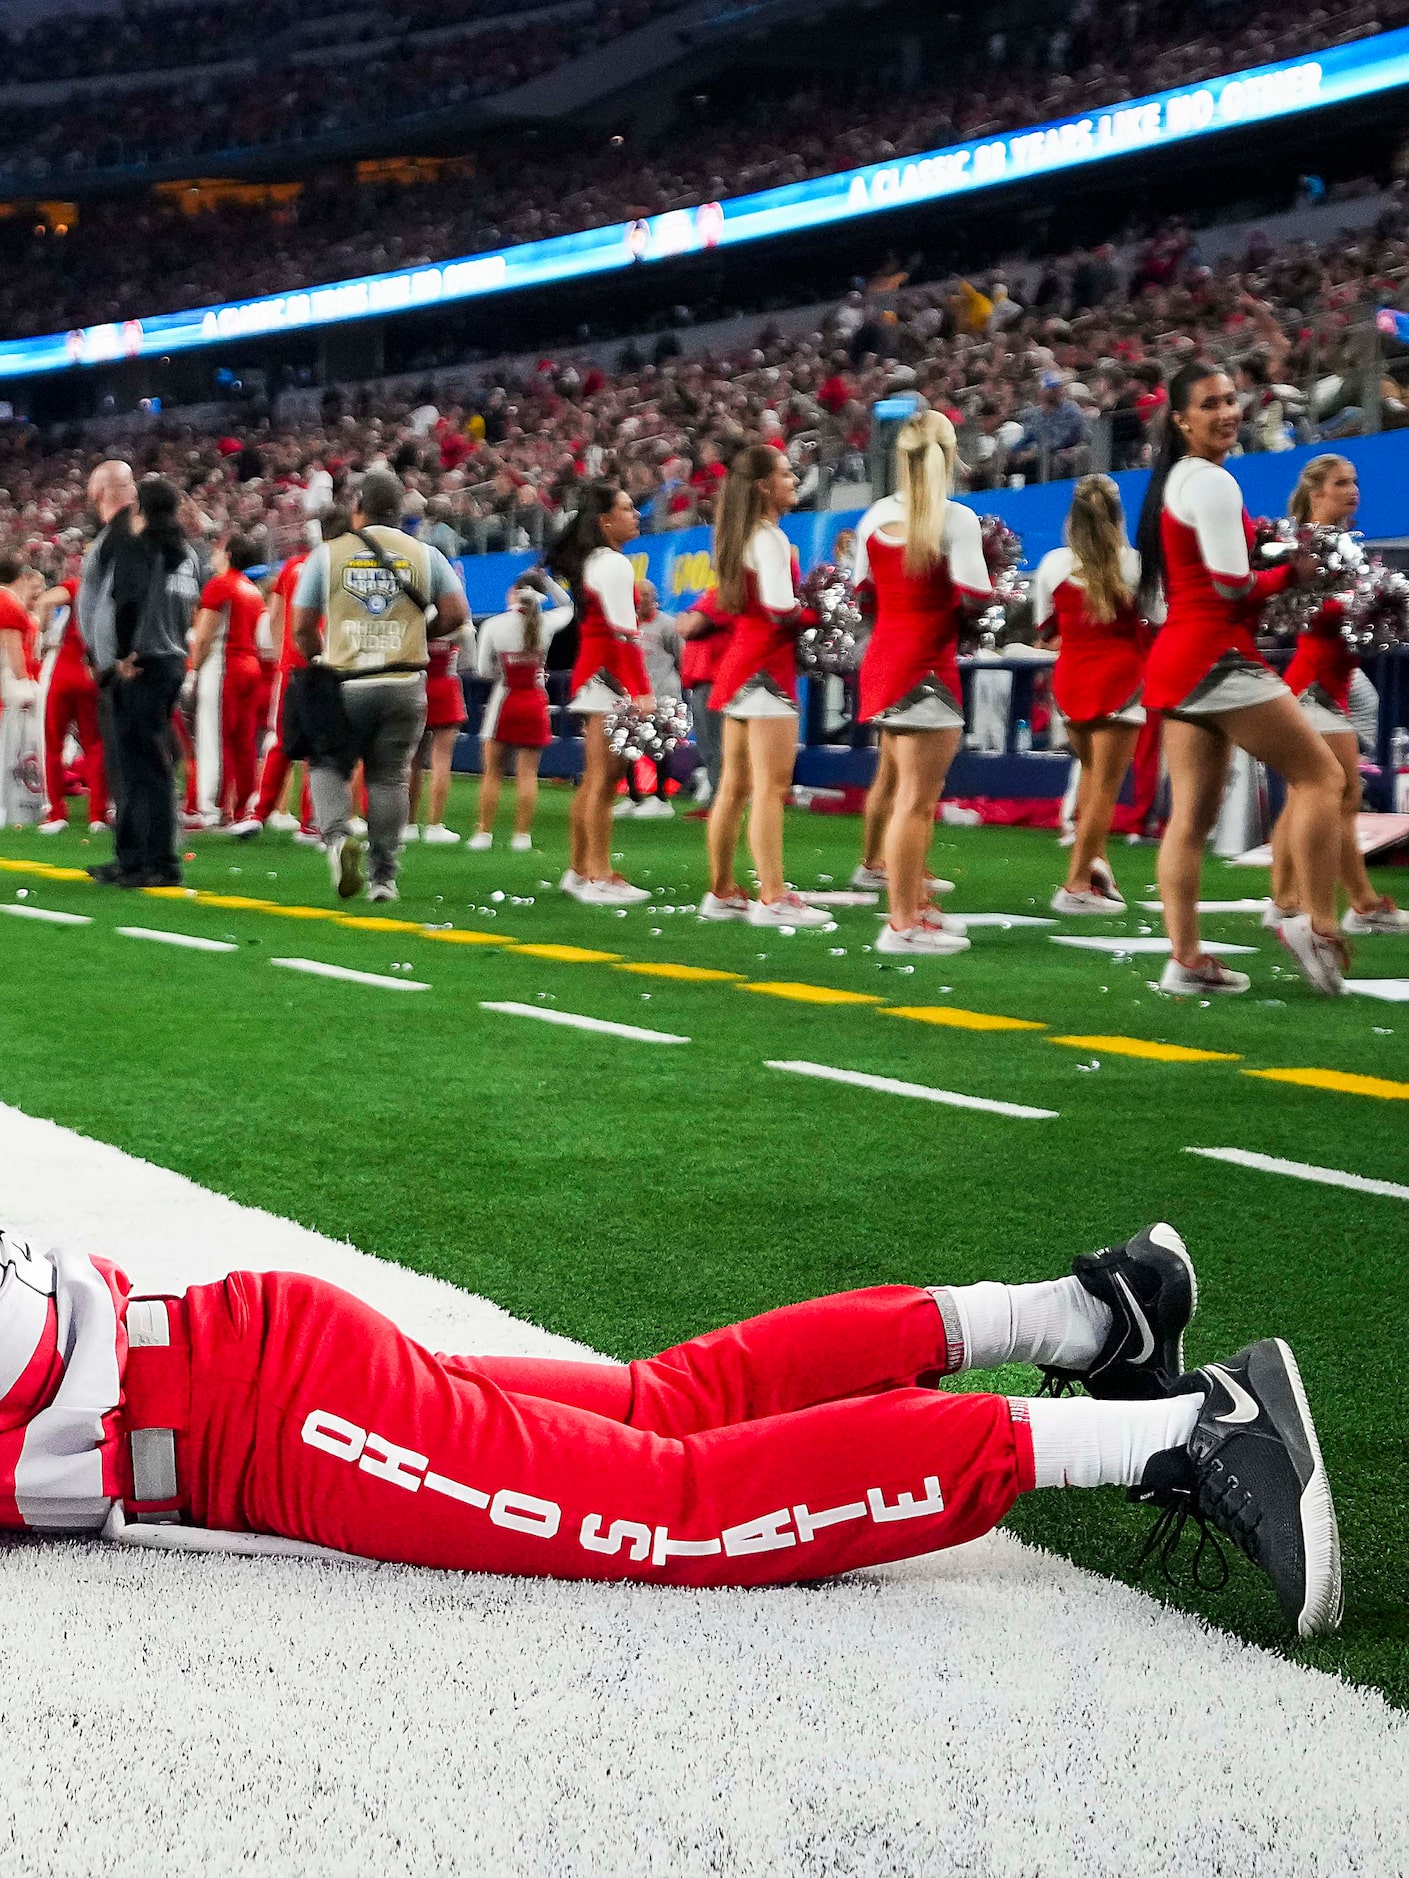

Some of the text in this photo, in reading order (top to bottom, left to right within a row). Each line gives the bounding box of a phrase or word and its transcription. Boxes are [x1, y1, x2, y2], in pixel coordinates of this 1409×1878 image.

[848, 176, 869, 204] A
[1098, 102, 1161, 146] LIKE
[1166, 90, 1214, 133] NO
[301, 1409, 946, 1566] OHIO STATE
